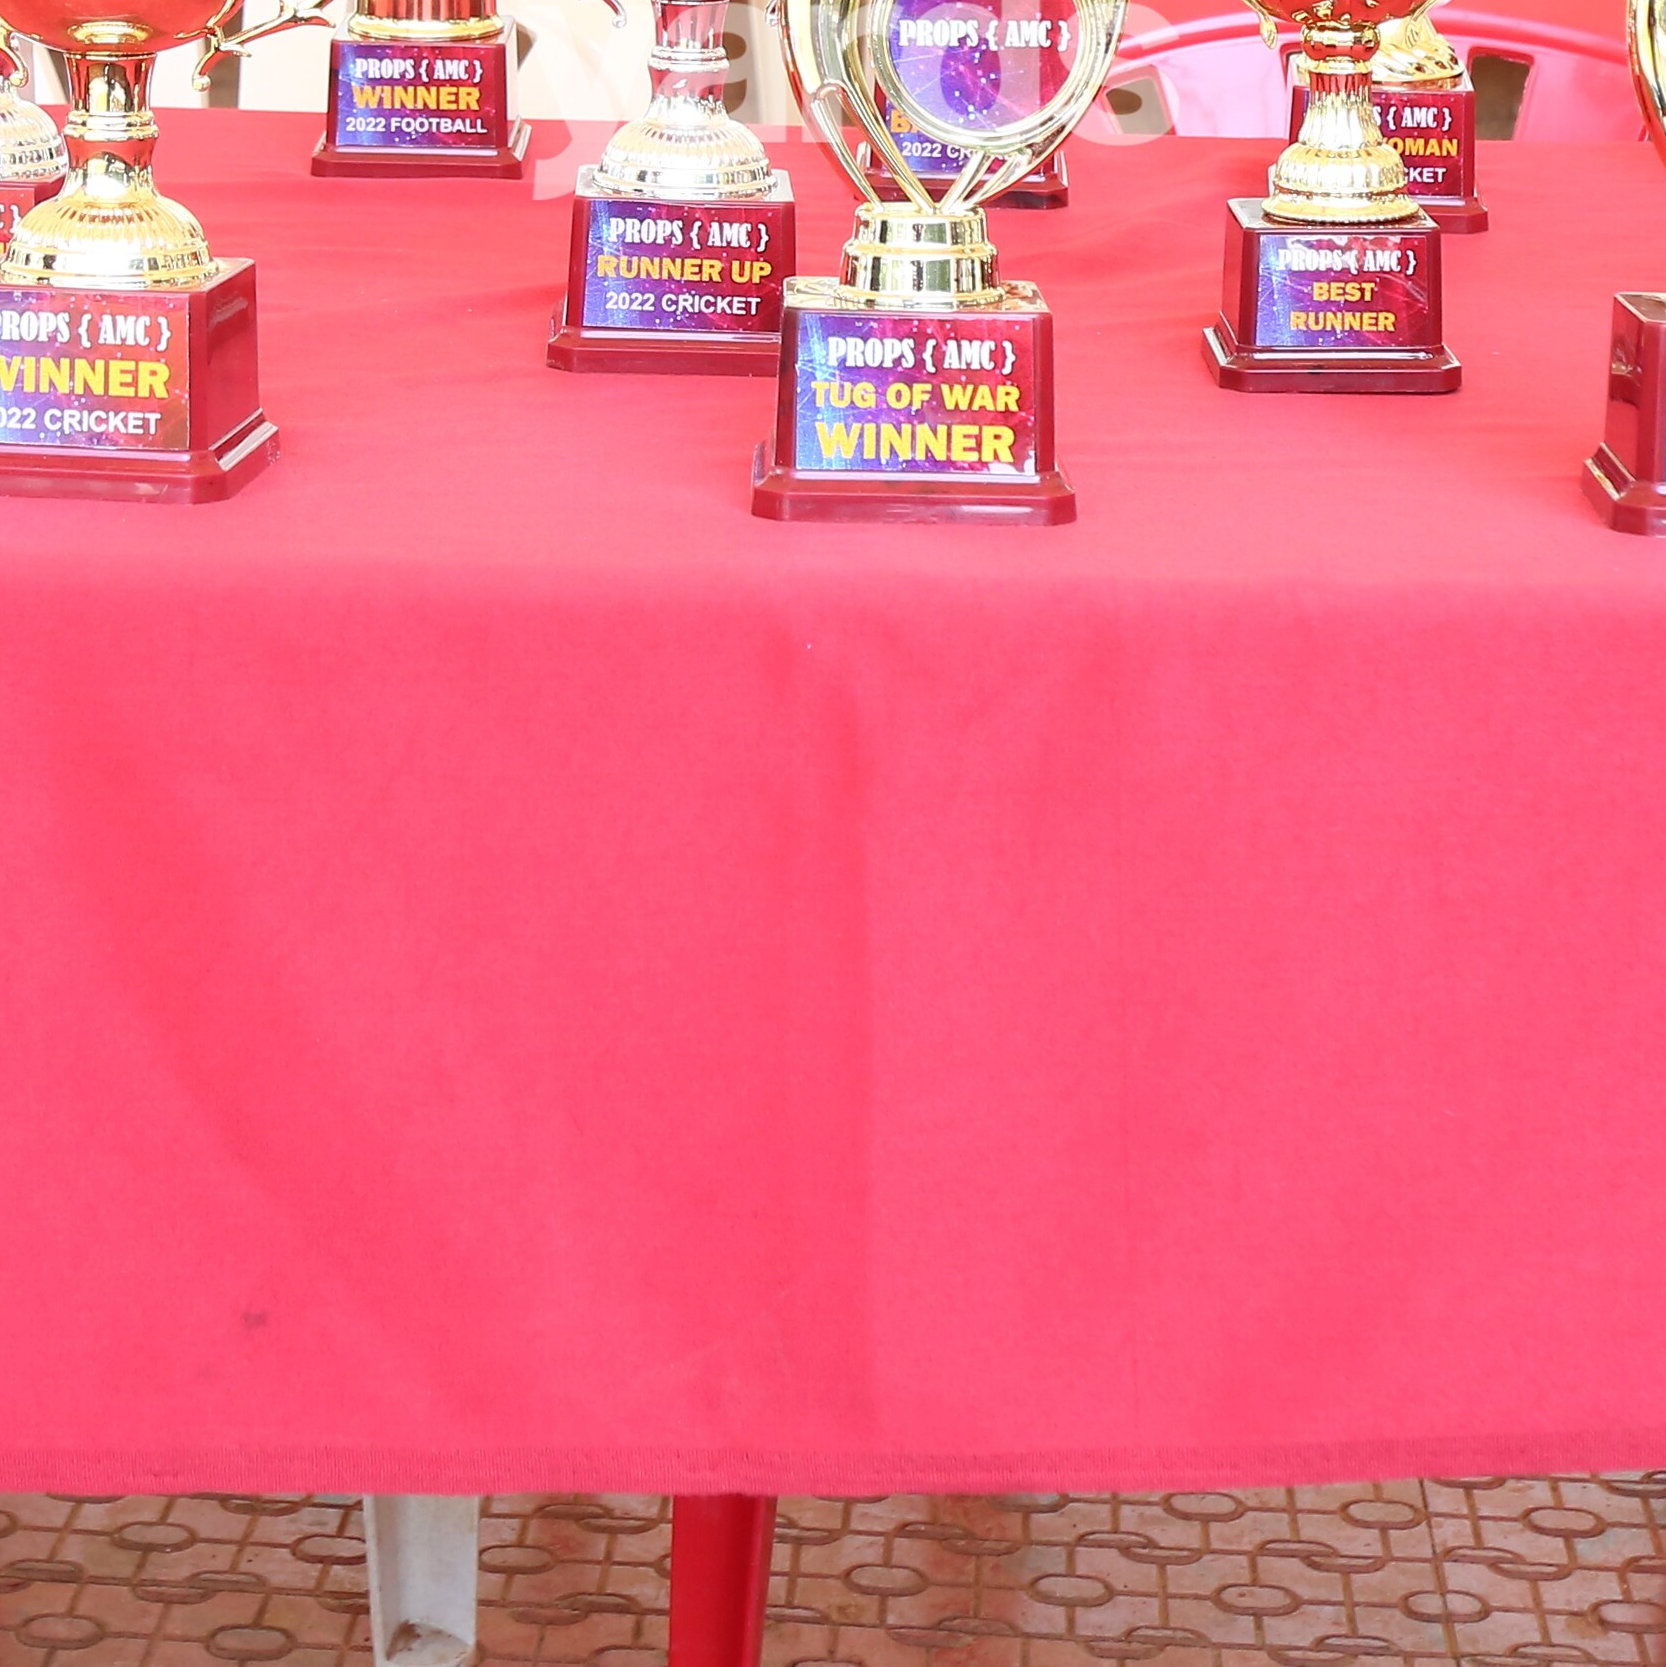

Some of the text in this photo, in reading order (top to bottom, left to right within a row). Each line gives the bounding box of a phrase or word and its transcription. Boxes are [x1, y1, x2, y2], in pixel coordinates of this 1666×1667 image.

[899, 21, 980, 48] PROPS
[1004, 20, 1054, 48] AMC
[355, 58, 415, 80] PROPS
[434, 61, 469, 80] AMC
[352, 85, 480, 111] WINNER
[345, 116, 487, 134] 2022 FOOTBALL
[902, 142, 942, 157] 2022
[609, 217, 684, 247] PROPS
[707, 221, 752, 248] AMC
[597, 255, 773, 286] RUNNER UP
[1277, 248, 1343, 272] PROPS
[1363, 250, 1402, 273] AMC
[606, 293, 761, 316] 2022 CRICKET
[1313, 282, 1375, 302] BEST
[99, 315, 150, 346] AMC
[1289, 311, 1396, 333] RUNNER
[827, 338, 916, 368] PROPS
[943, 339, 996, 369] AMC
[811, 380, 1021, 413] TUG OF WAR
[46, 408, 162, 435] CRICKET
[816, 421, 1016, 463] WINNER
